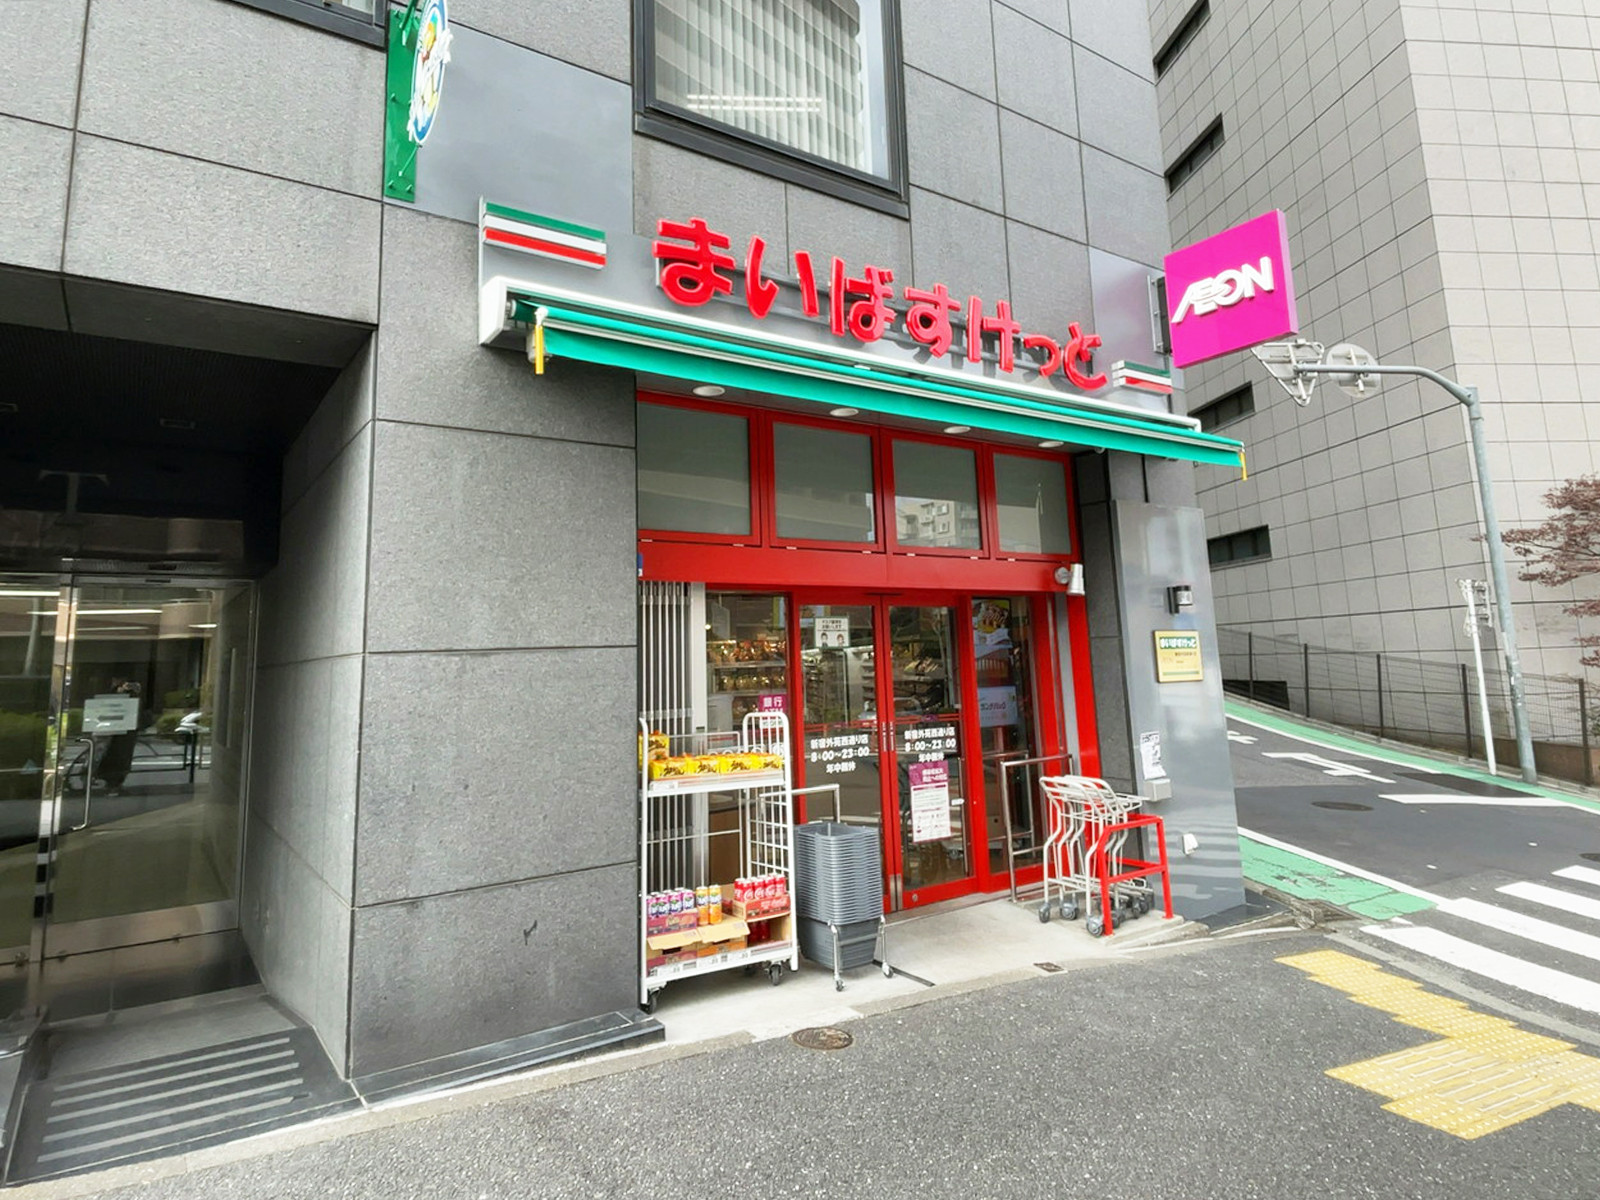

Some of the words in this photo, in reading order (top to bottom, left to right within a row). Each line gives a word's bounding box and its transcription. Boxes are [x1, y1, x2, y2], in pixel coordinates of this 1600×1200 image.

[653, 217, 1109, 392] まいばすけっと
[1171, 256, 1275, 323] AEON
[763, 696, 783, 708] 銀行
[810, 734, 869, 749] 新宿外苑西通り店
